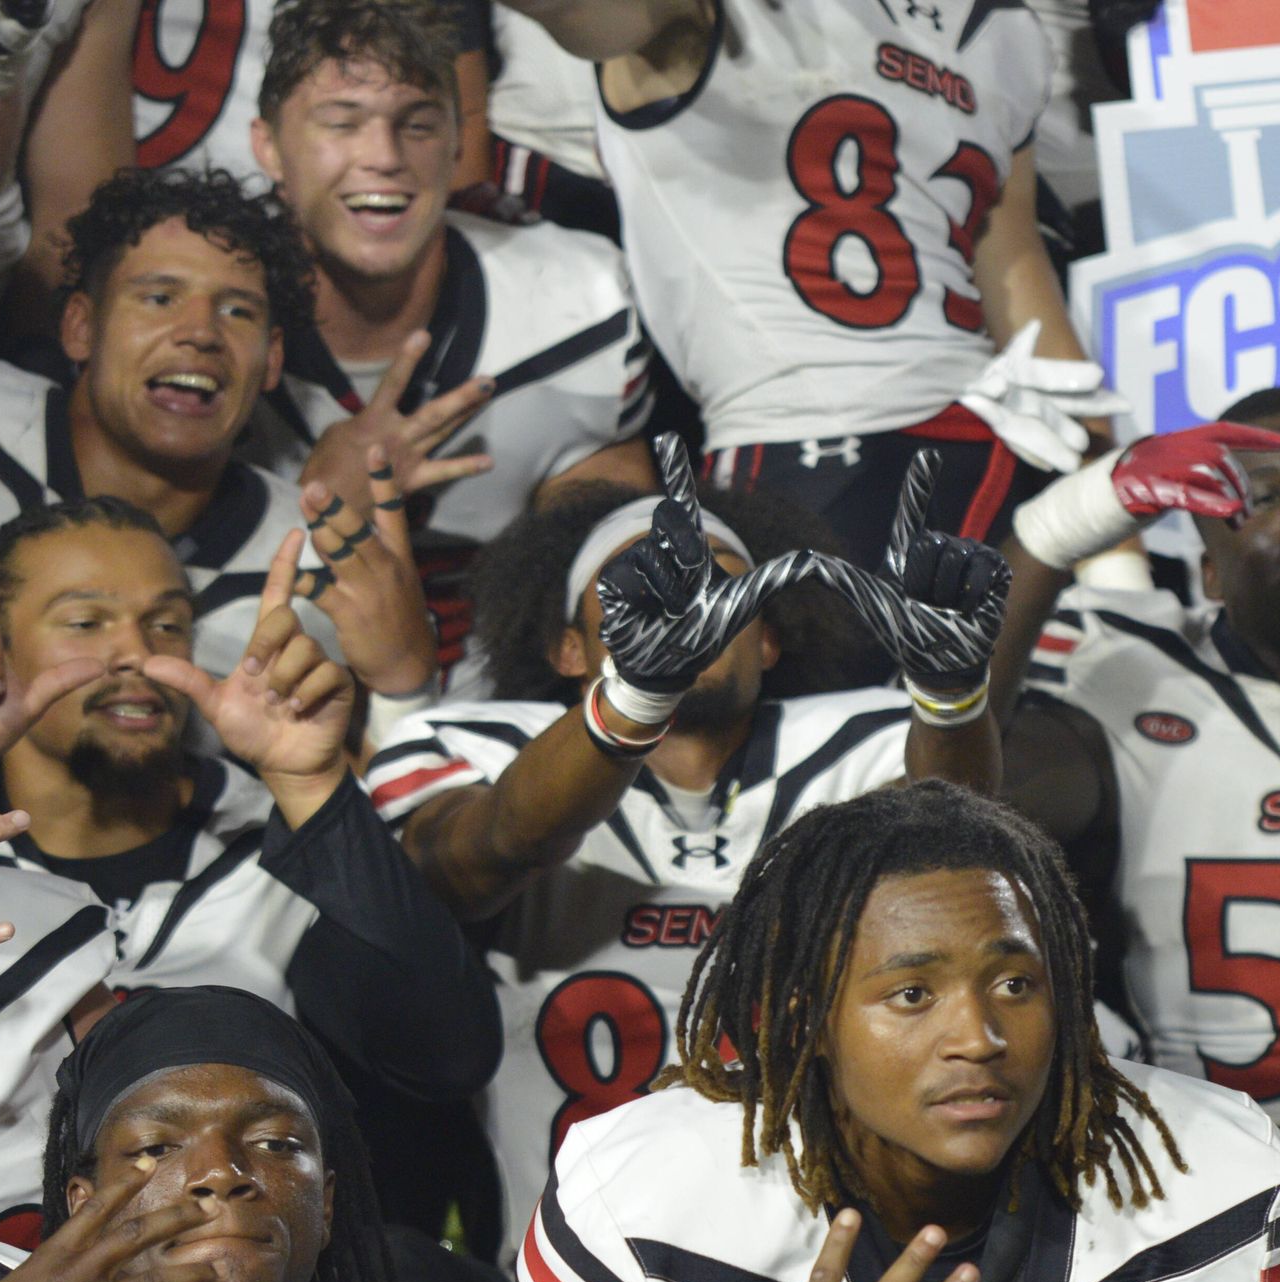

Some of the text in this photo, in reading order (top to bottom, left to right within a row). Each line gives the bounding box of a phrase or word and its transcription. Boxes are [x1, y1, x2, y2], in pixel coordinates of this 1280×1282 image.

[877, 42, 977, 115] SEMO
[1147, 720, 1182, 738] OVC
[622, 904, 724, 949] SEM
